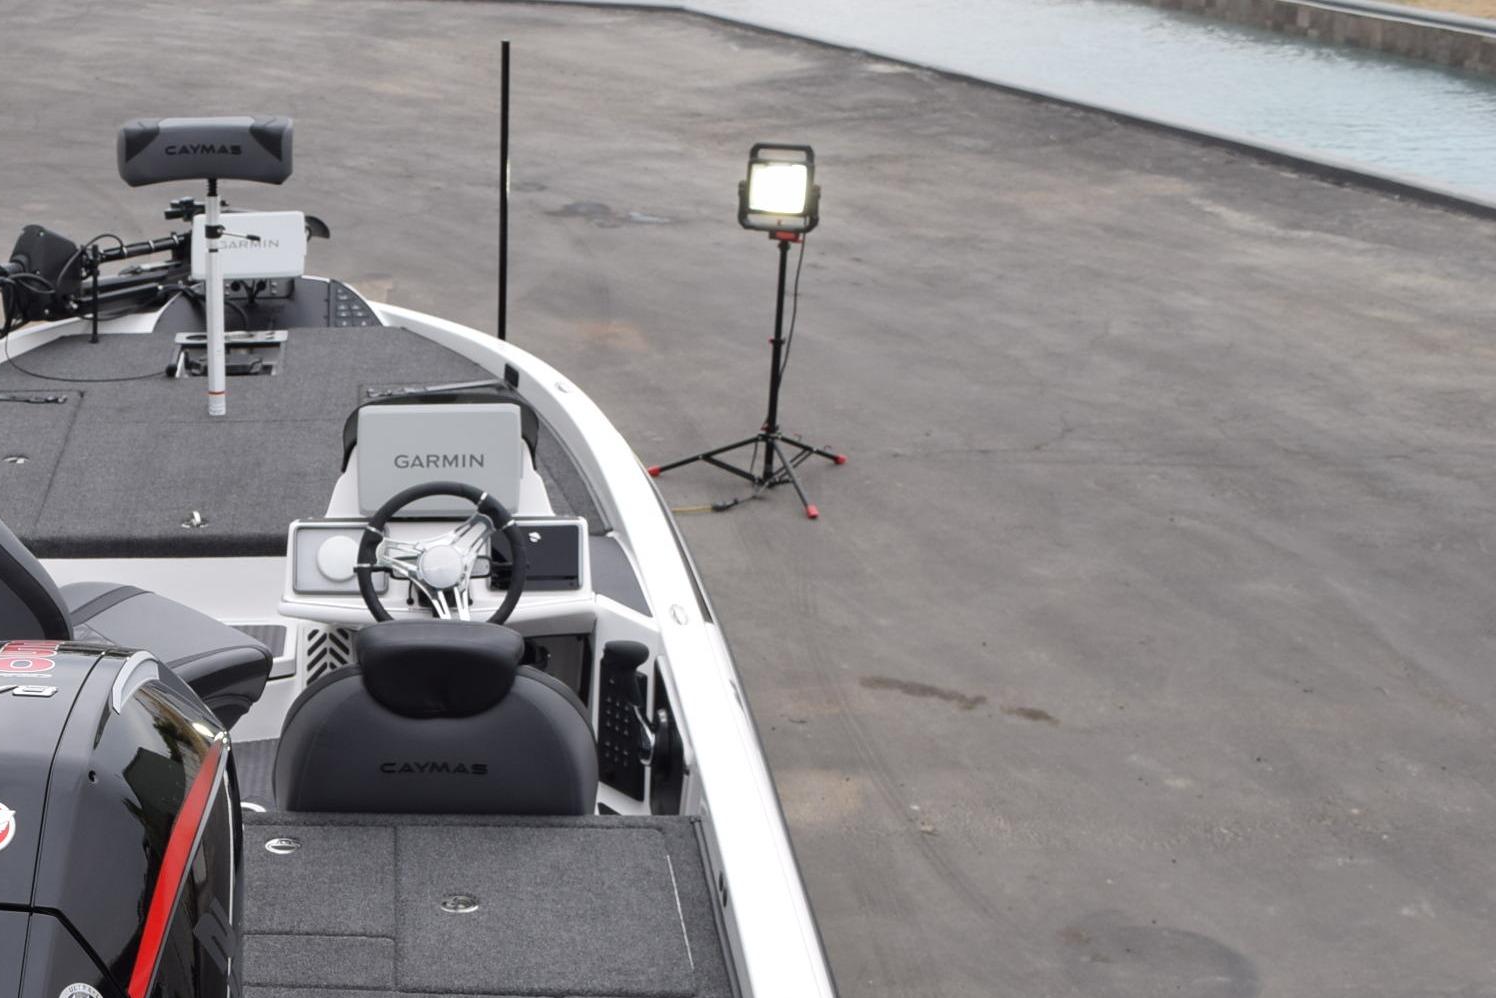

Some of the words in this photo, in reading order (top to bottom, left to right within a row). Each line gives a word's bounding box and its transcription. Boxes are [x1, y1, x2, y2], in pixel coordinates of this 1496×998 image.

[164, 144, 242, 156] CAYMAS
[393, 453, 485, 469] GARMIN
[379, 761, 489, 775] CAYMAS
